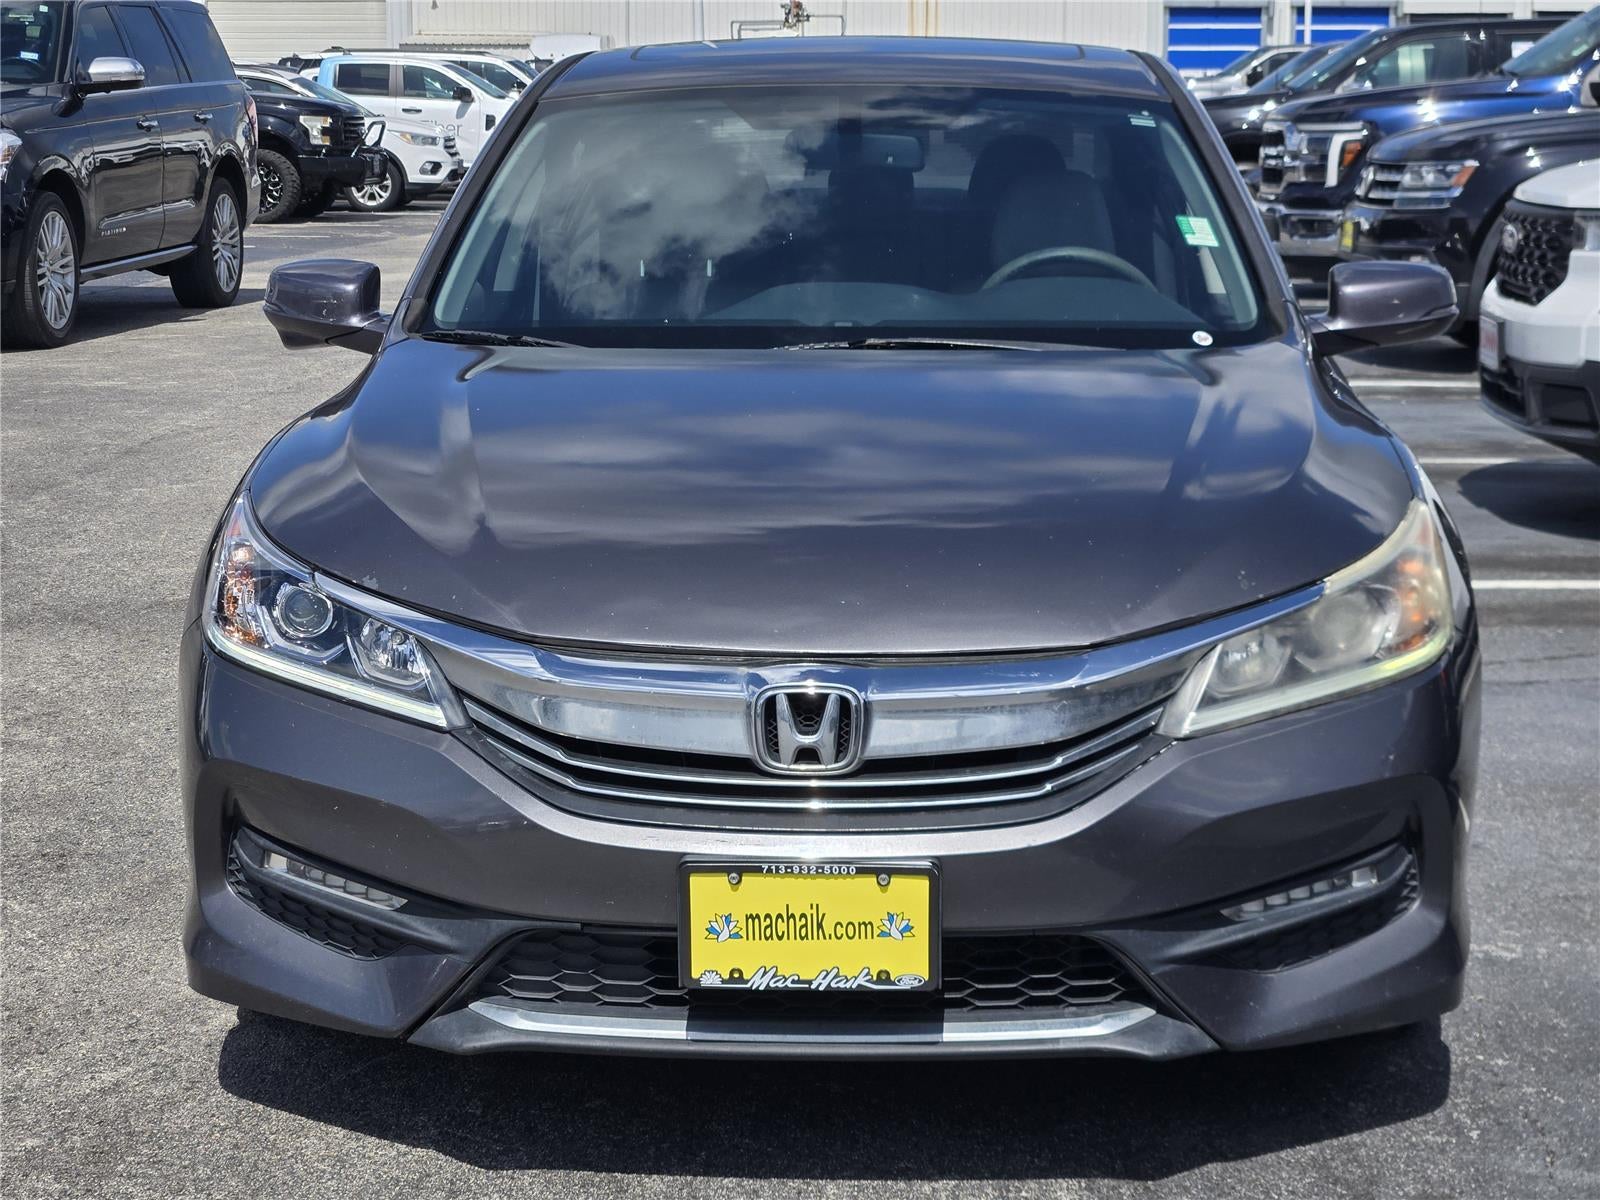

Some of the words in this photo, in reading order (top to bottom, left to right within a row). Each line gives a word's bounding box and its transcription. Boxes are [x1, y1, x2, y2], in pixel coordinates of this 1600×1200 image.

[761, 865, 856, 875] 713-932-5000
[744, 903, 875, 941] machaik.com
[748, 966, 802, 990] Mac
[810, 966, 874, 990] Haik
